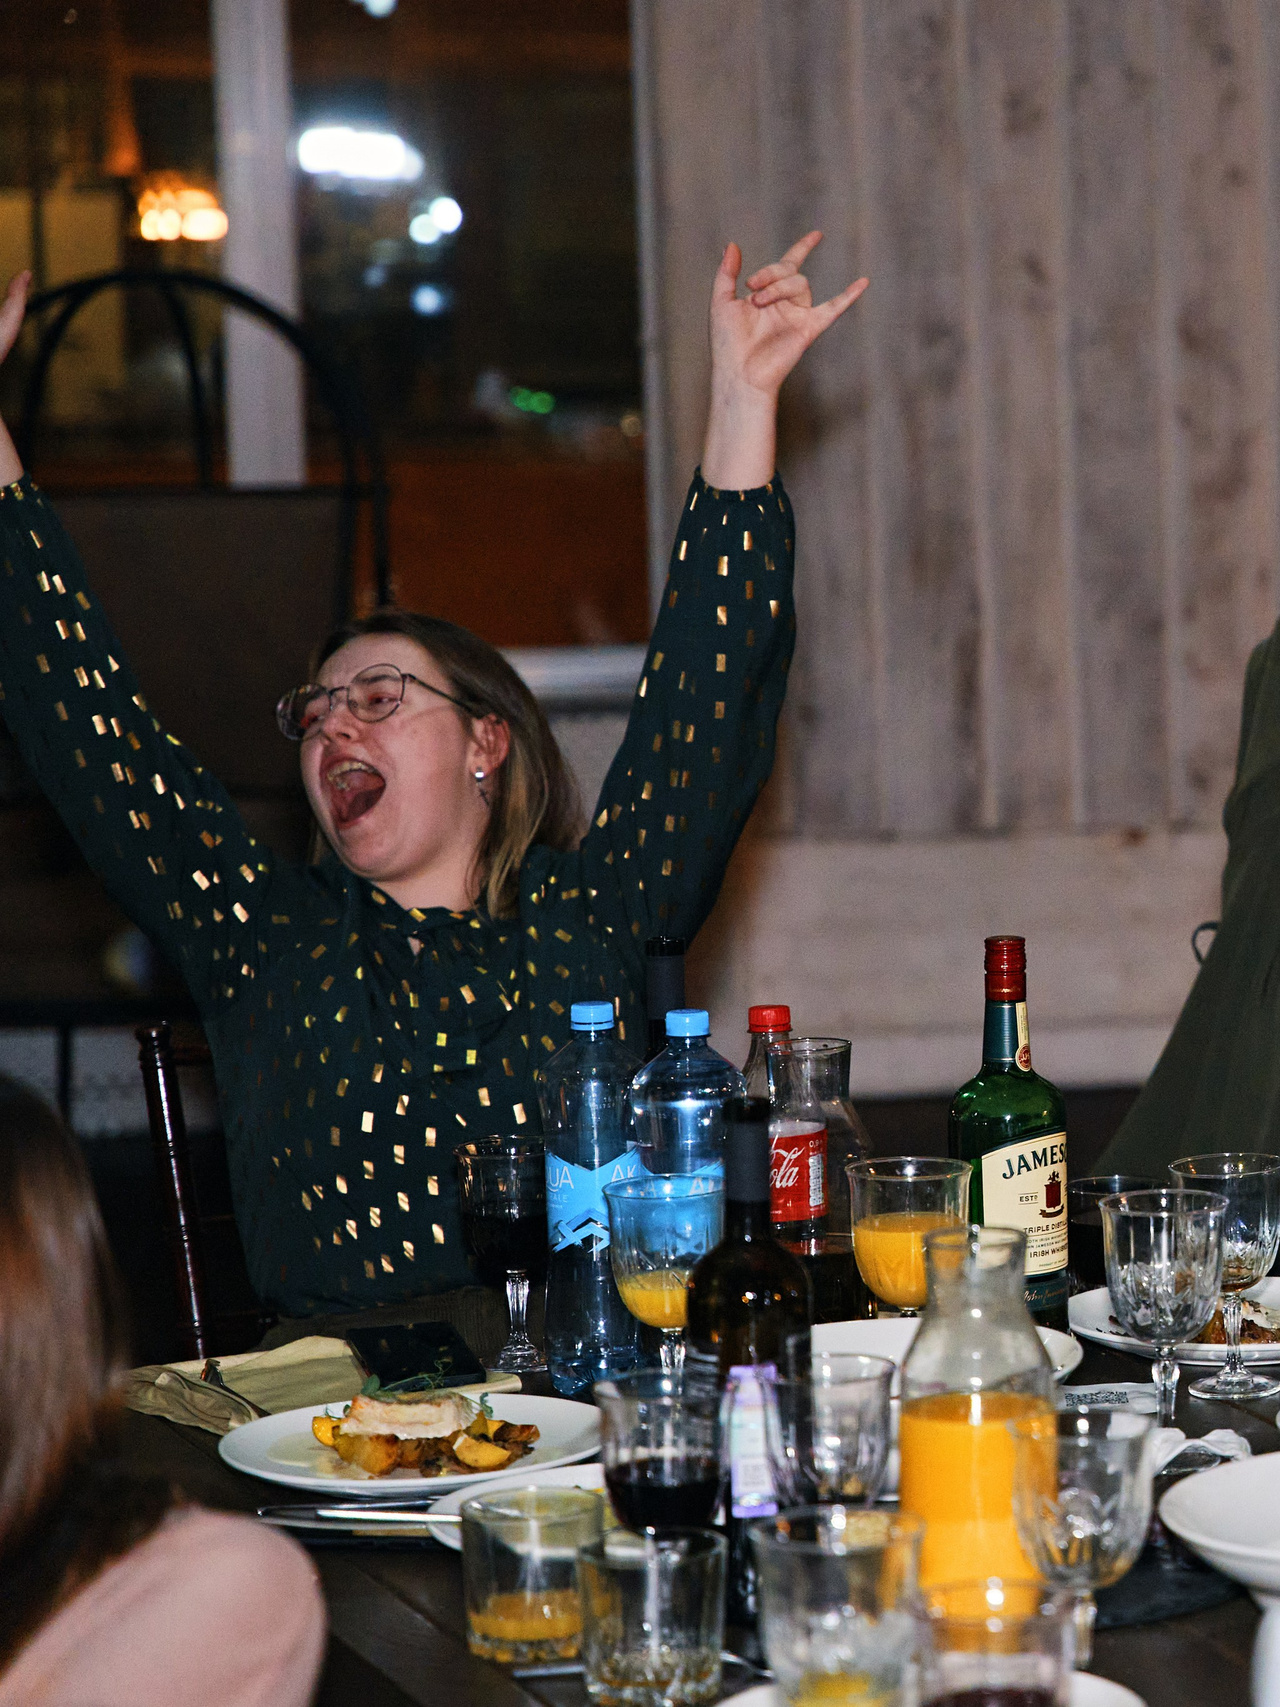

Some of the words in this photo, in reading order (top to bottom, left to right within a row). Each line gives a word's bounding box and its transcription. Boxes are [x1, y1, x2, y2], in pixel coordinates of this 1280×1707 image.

[1002, 1143, 1067, 1180] JAMES
[1023, 1225, 1050, 1233] TRIPLE
[1030, 1250, 1050, 1258] IRISH
